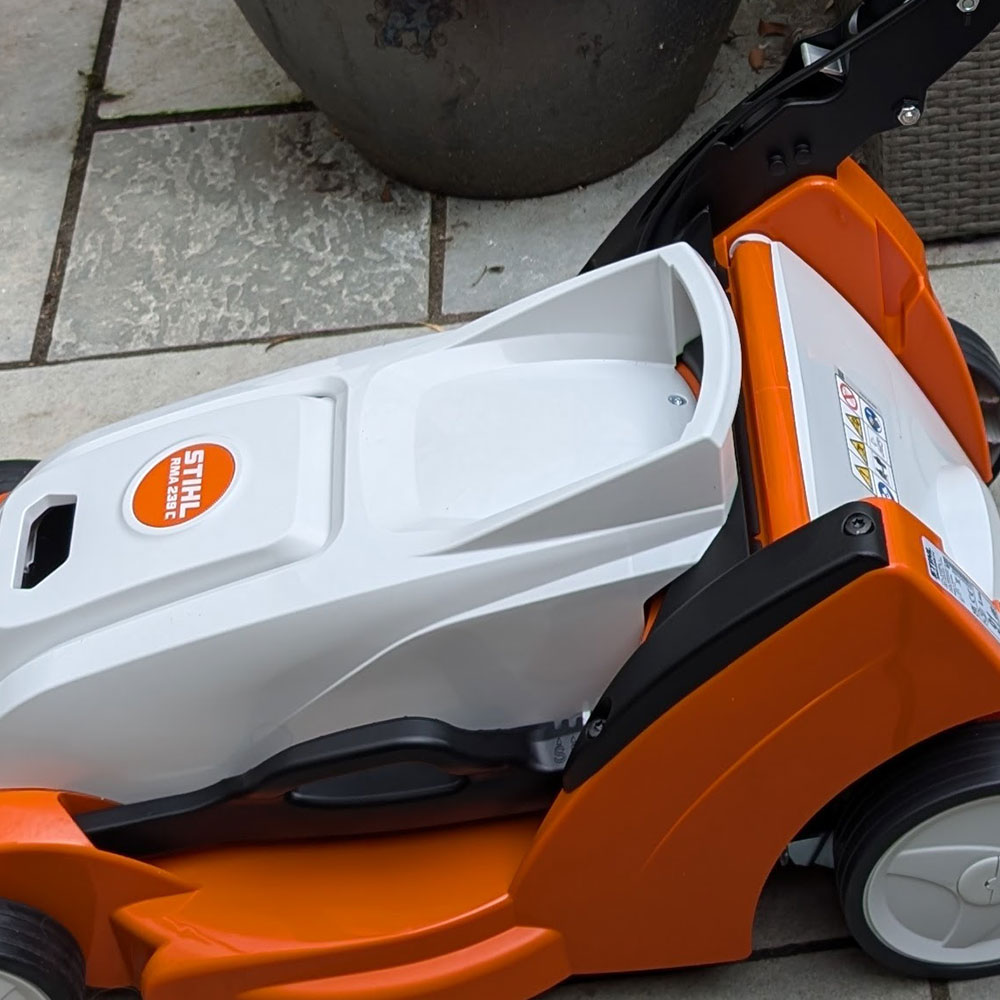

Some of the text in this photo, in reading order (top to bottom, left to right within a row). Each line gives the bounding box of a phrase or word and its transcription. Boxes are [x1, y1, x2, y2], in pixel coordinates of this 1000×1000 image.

[164, 457, 181, 520] RMA 239 C
[180, 450, 204, 518] STIHL
